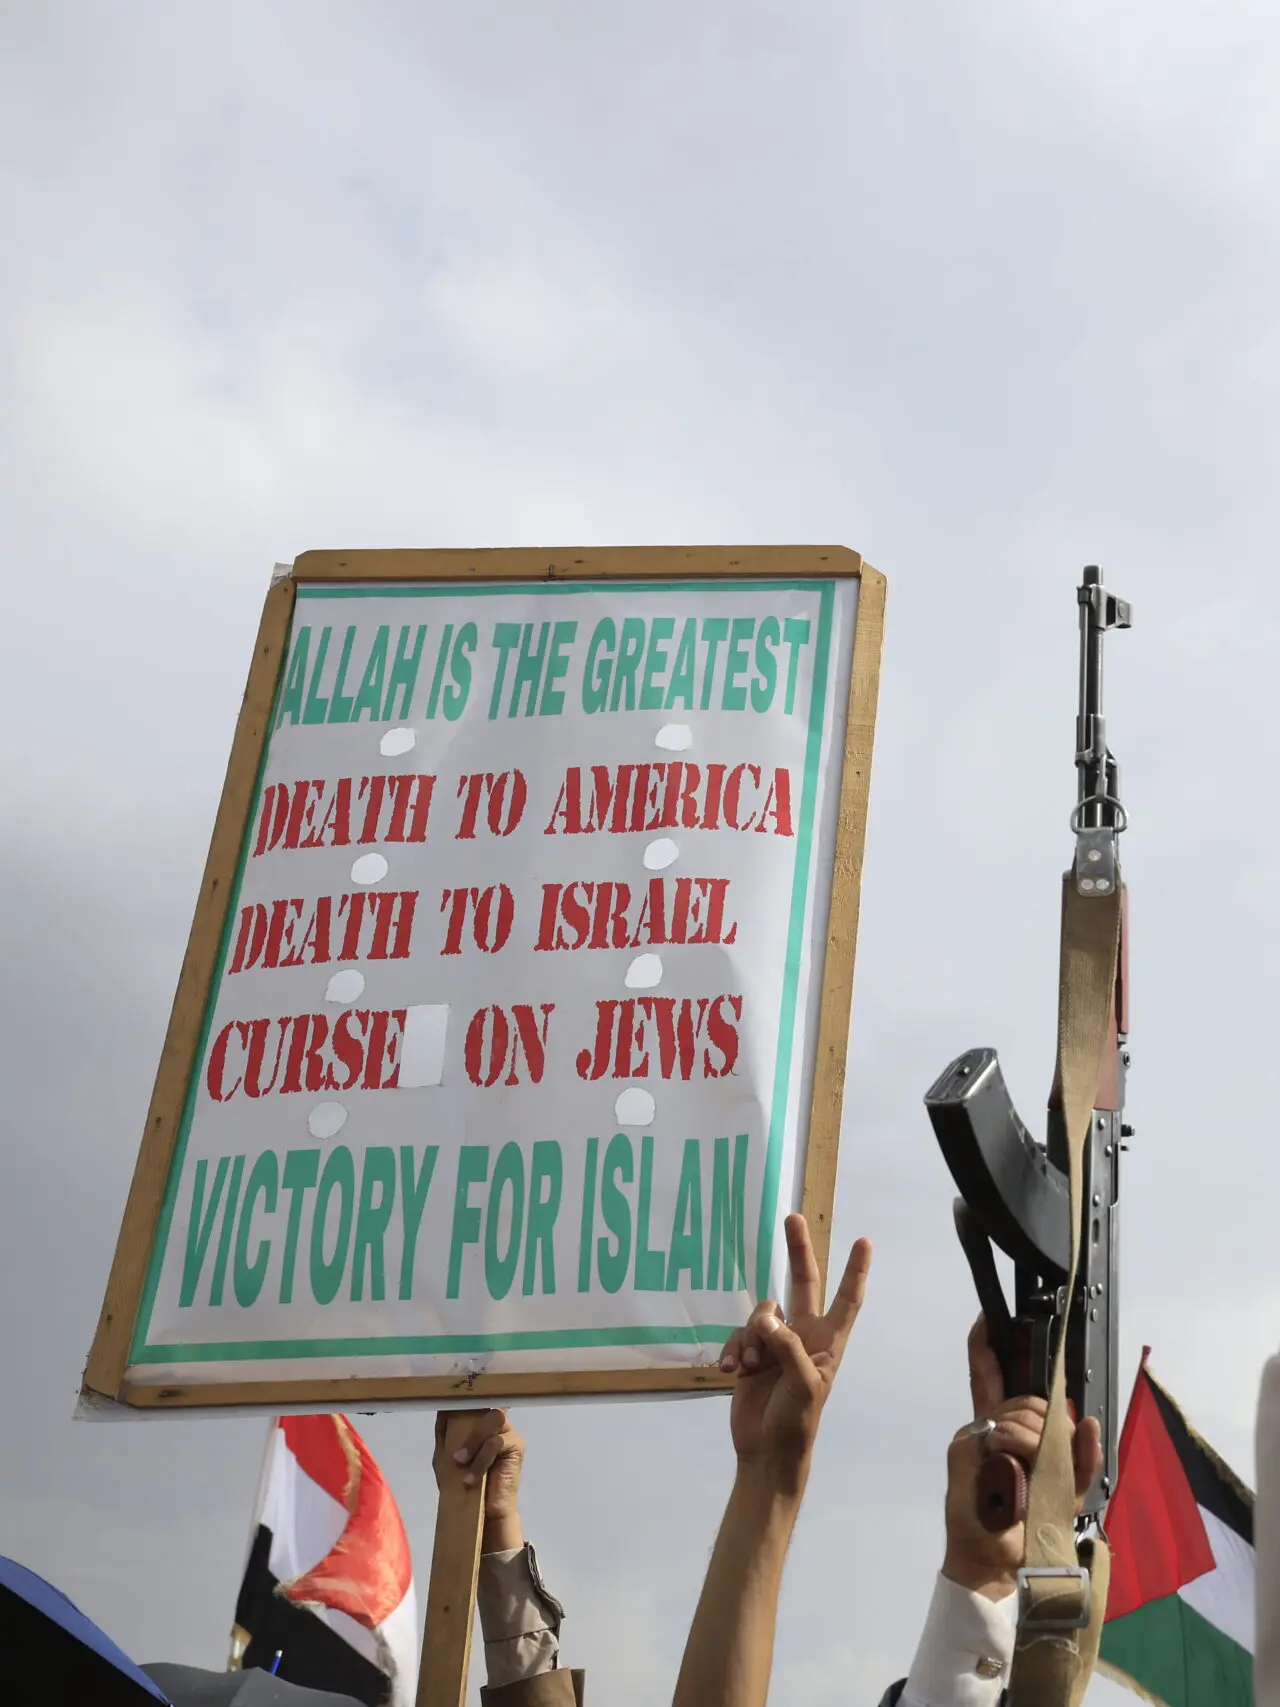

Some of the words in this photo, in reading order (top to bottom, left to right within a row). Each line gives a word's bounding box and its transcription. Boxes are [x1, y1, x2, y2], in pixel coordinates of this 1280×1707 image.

[277, 625, 427, 727] ALLAH
[427, 622, 476, 720] IS
[490, 622, 576, 719] THE
[583, 616, 810, 714] GREATEST
[253, 775, 436, 856] DEATH
[456, 770, 526, 838] TO
[544, 762, 793, 836] AMERICA
[229, 892, 418, 974] DEATH
[441, 884, 514, 955] TO
[534, 878, 737, 951] ISRAEL
[207, 1010, 406, 1101] CURSE
[465, 1004, 554, 1087] ON
[576, 996, 742, 1080] JEWS
[180, 1146, 438, 1307] VICTORY
[447, 1141, 562, 1300] FOR
[578, 1135, 748, 1293] ISLAM
